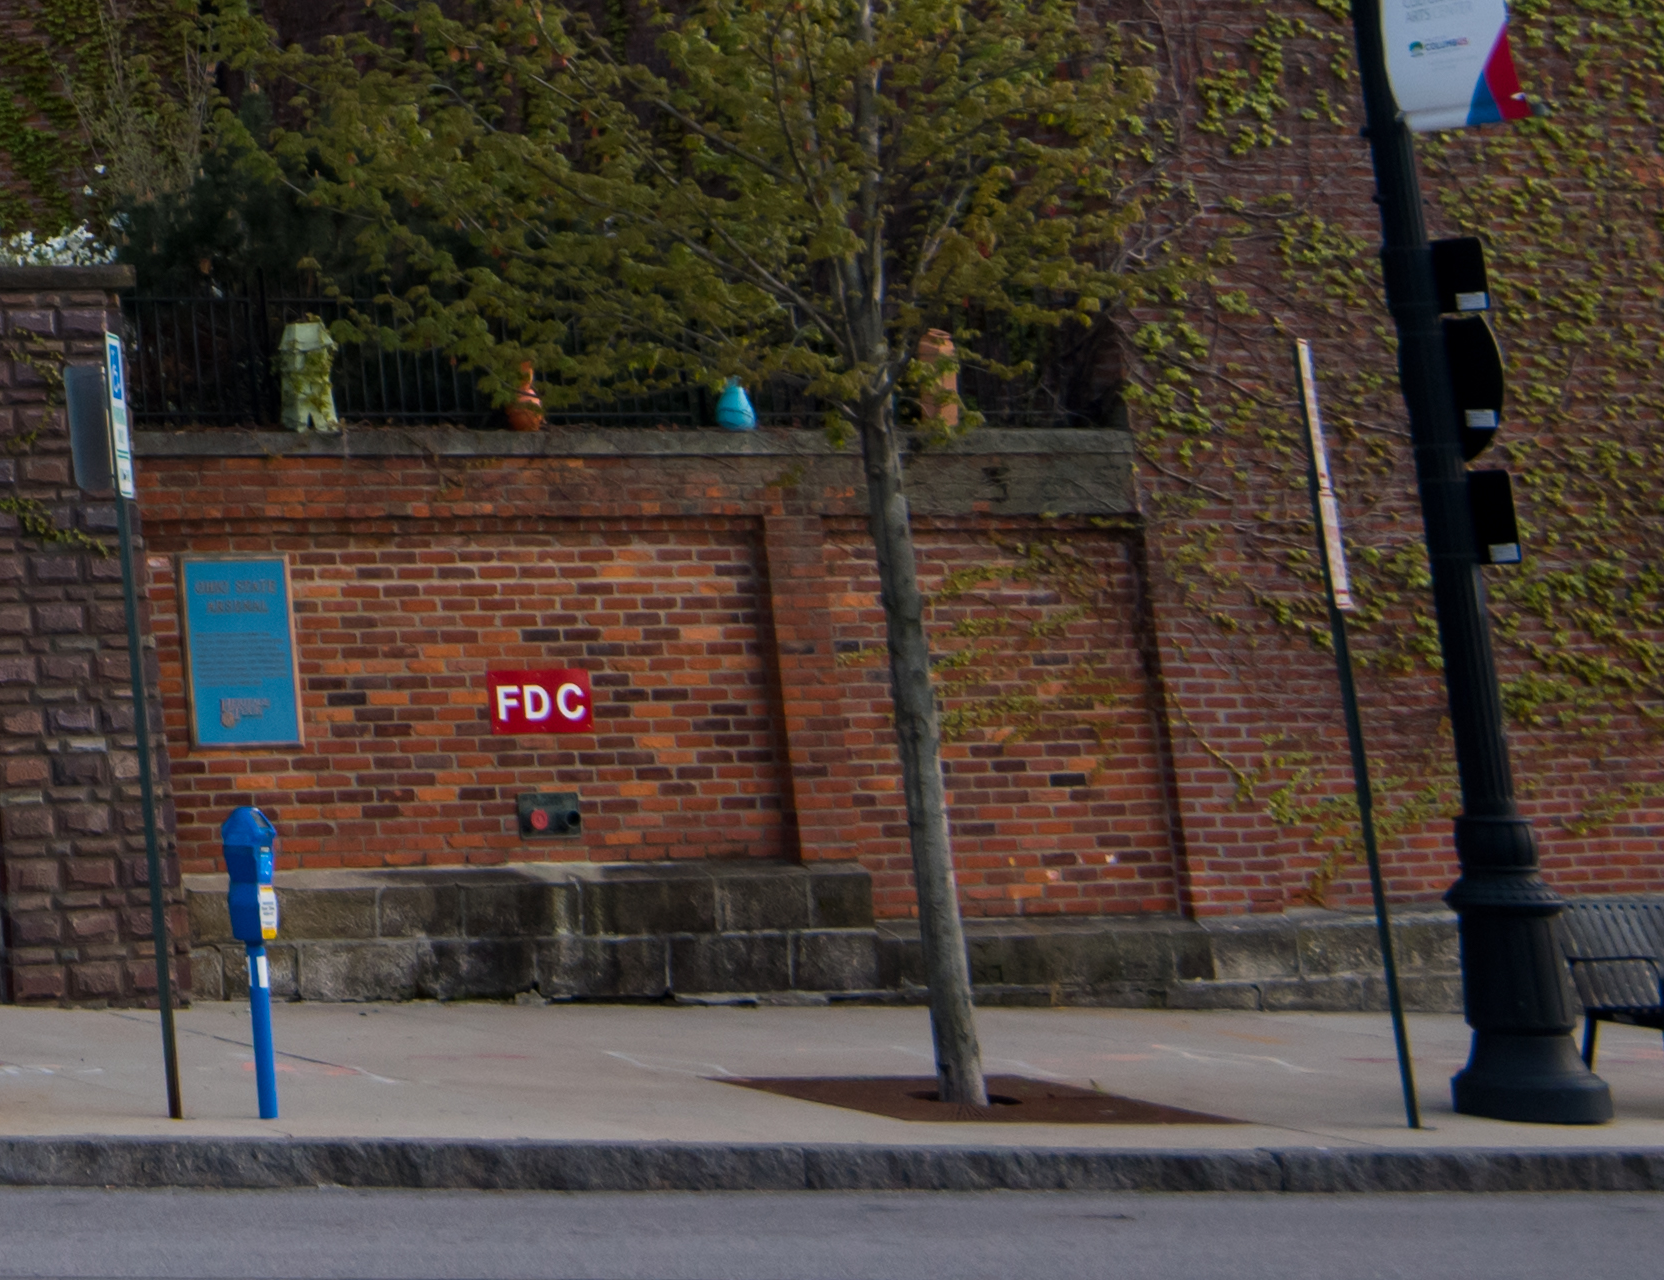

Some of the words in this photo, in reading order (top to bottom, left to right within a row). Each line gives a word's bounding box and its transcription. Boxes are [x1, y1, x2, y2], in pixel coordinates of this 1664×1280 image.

[235, 579, 277, 594] STATE
[206, 600, 268, 613] ARSENAL
[496, 683, 586, 721] FDC
